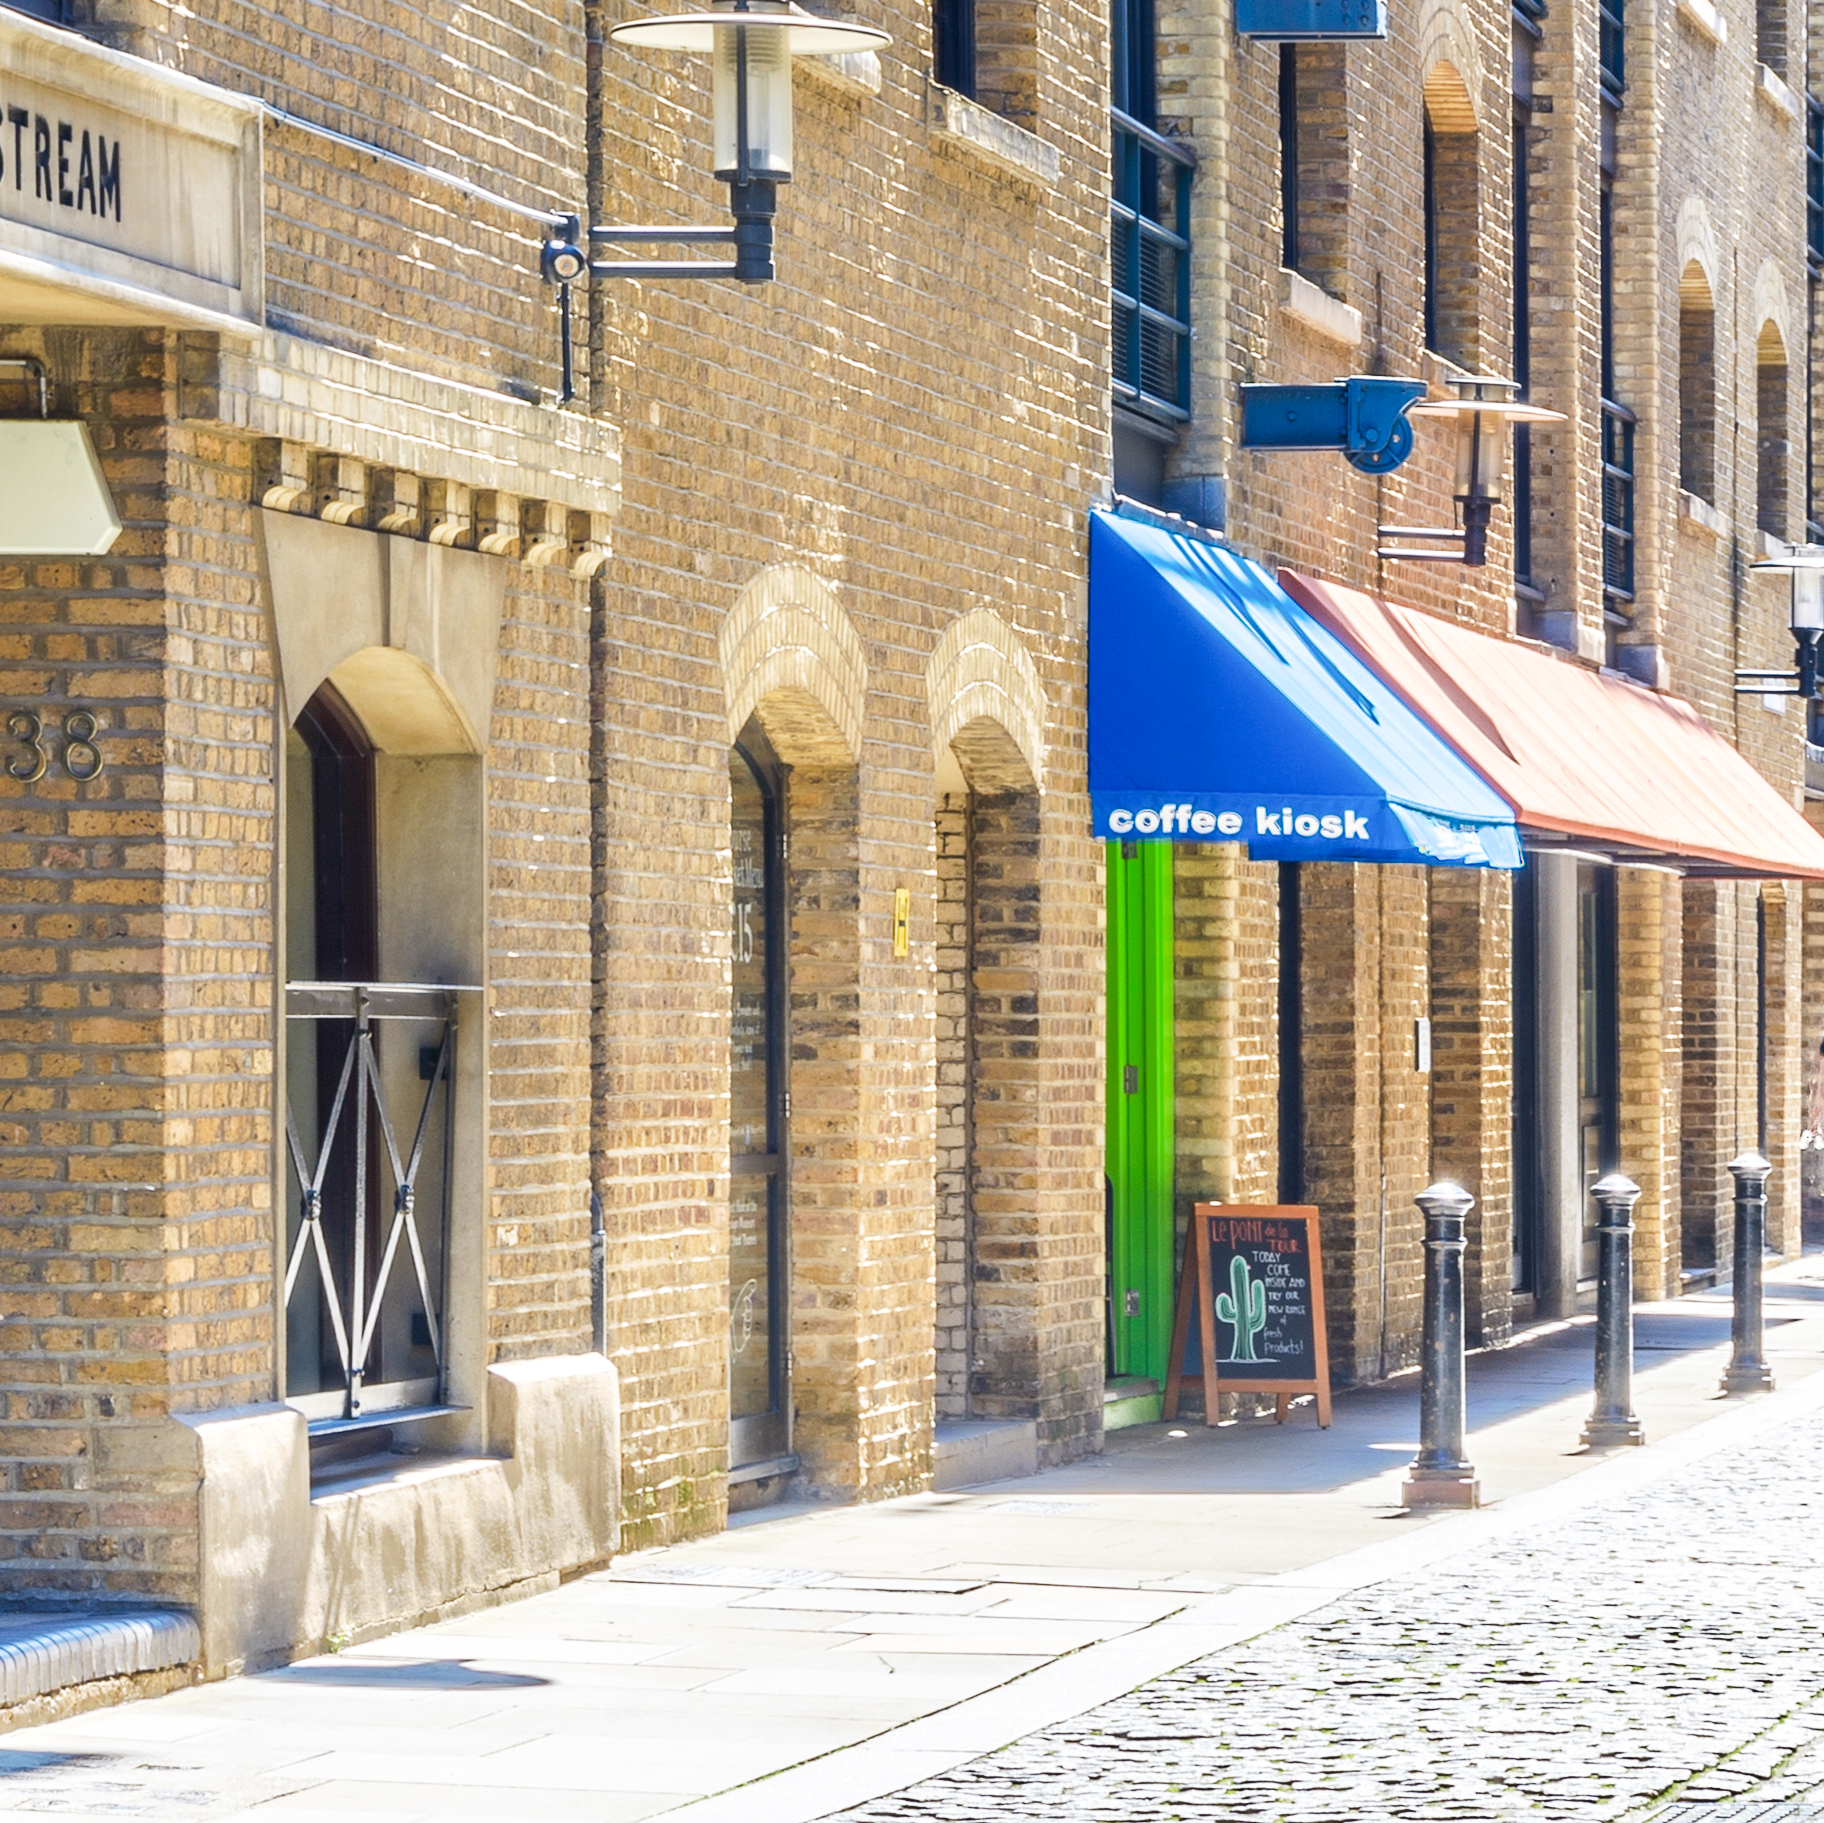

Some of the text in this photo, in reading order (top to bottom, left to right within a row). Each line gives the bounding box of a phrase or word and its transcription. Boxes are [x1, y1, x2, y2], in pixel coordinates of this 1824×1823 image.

[4, 708, 104, 783] 38
[1109, 803, 1370, 840] coffee kiosk
[1252, 1250, 1281, 1263] TODAY
[1267, 1264, 1291, 1277] COME
[1288, 1277, 1306, 1288] AND
[1268, 1291, 1300, 1301] TRY OUR
[1268, 1305, 1284, 1315] NEW
